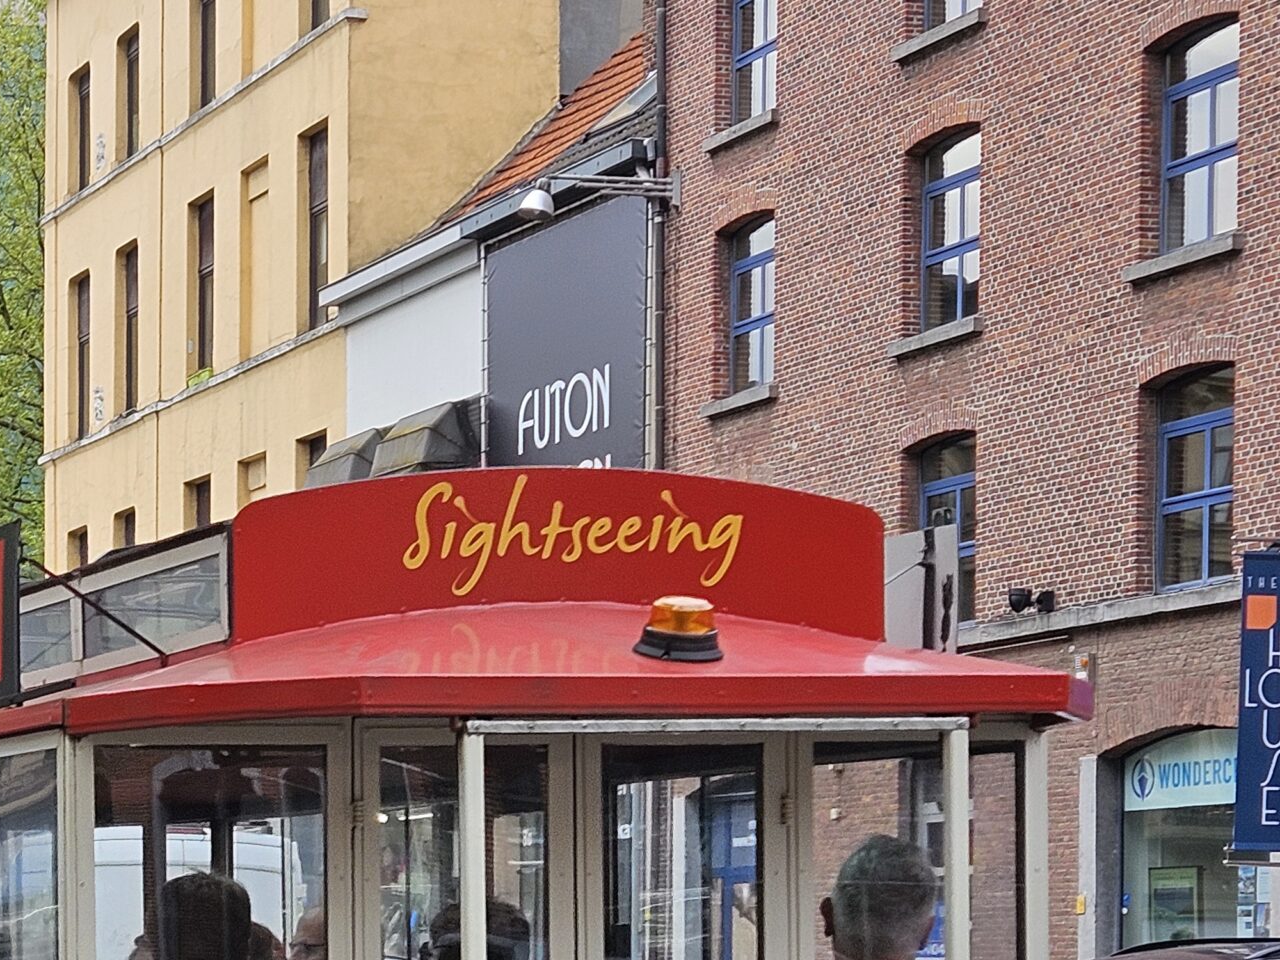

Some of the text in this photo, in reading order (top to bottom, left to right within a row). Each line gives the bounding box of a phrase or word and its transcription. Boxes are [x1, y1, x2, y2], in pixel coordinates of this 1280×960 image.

[517, 363, 611, 456] FUTON
[402, 474, 745, 597] Sightseeing
[1247, 575, 1278, 589] THE
[1158, 757, 1238, 790] WONDERC
